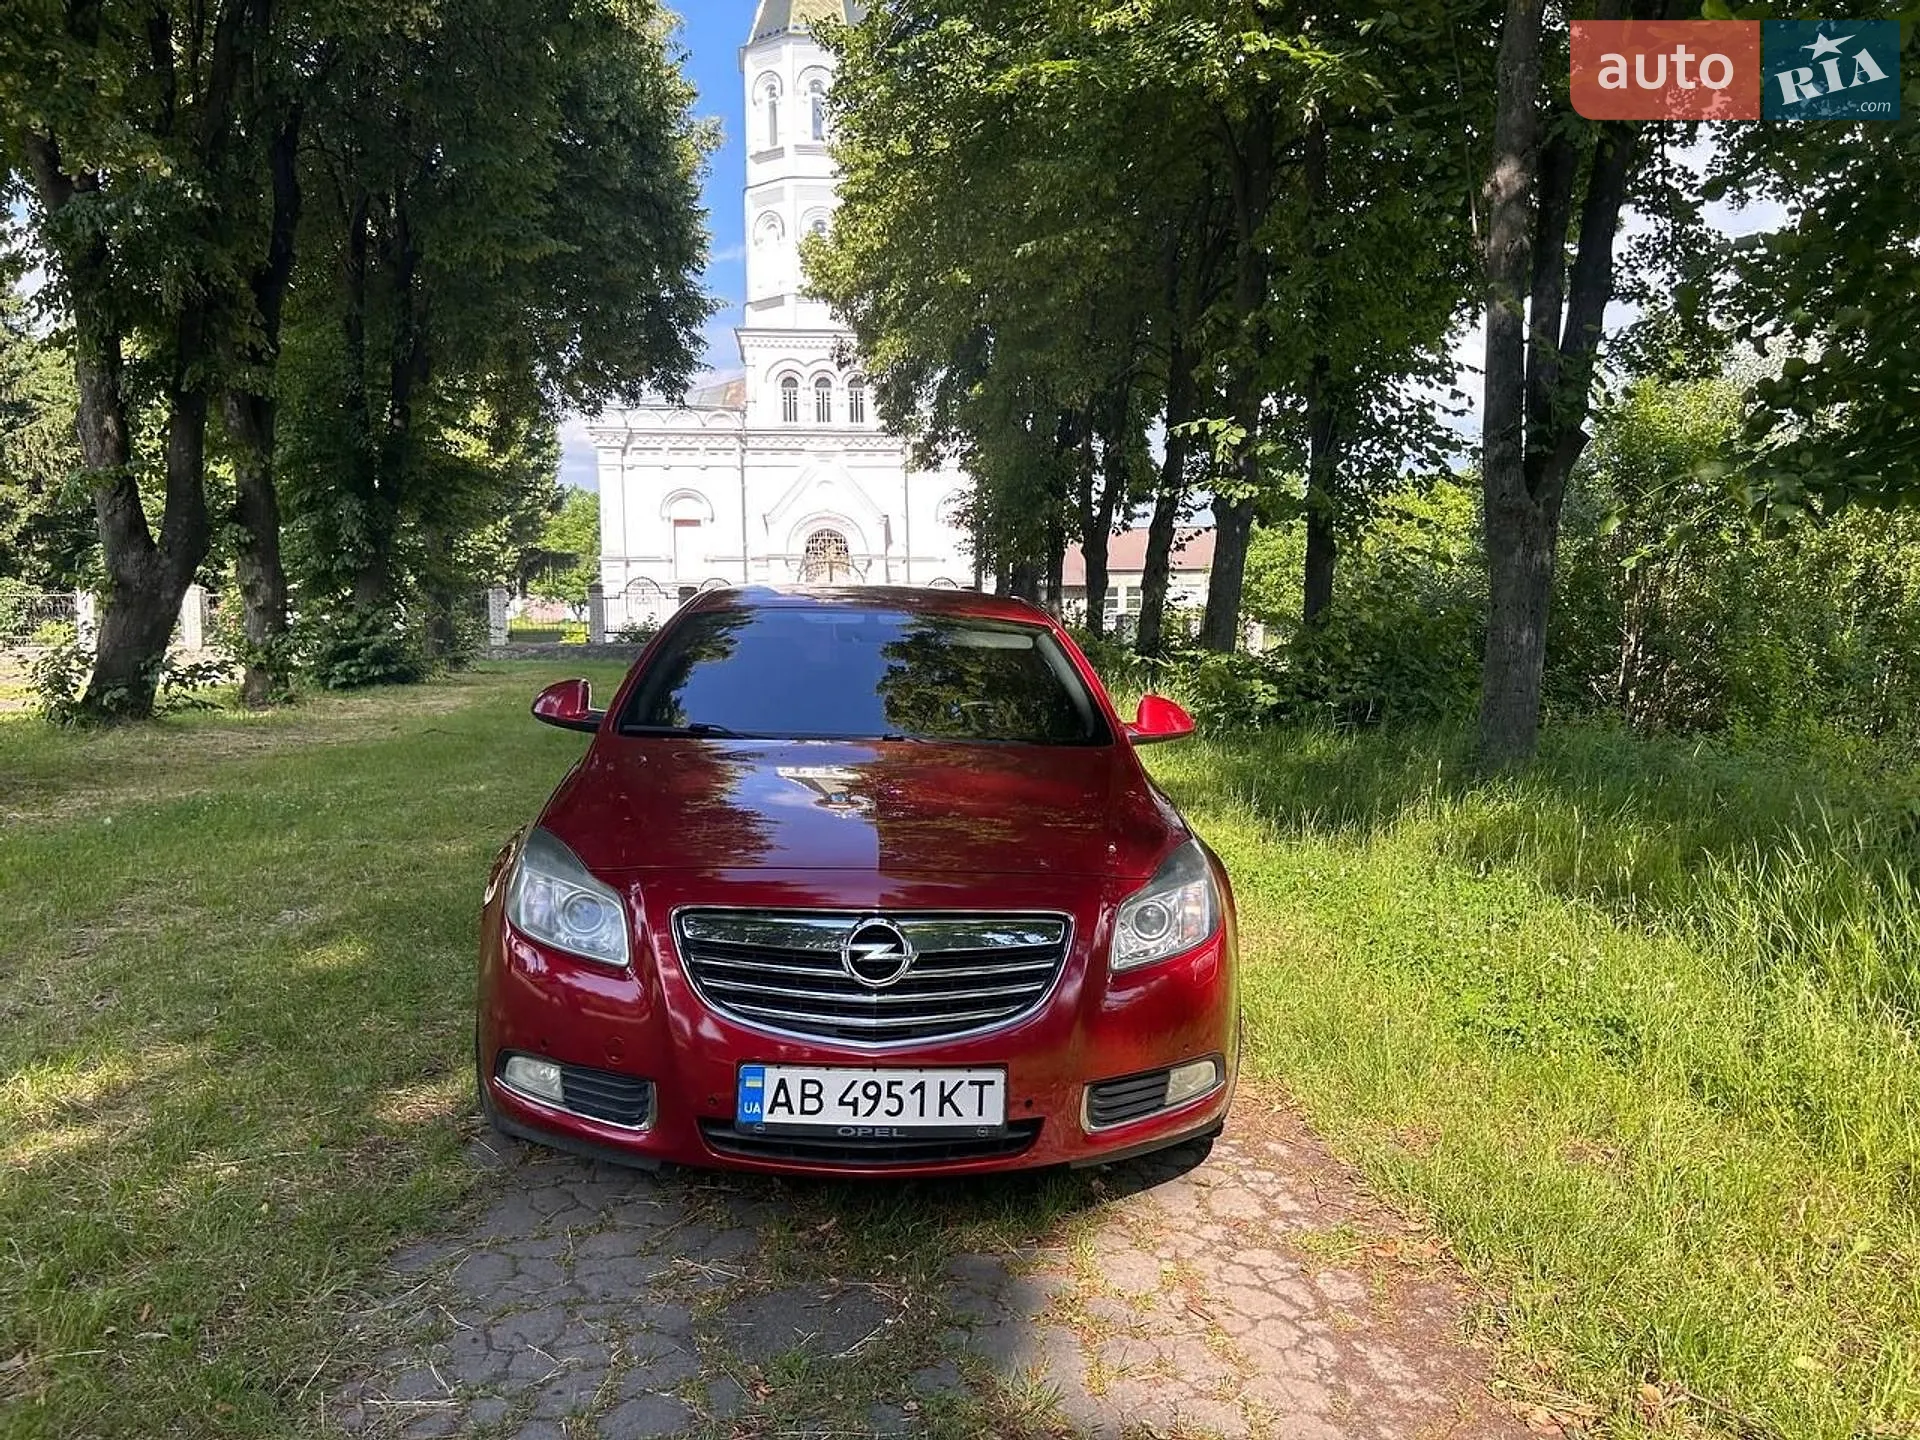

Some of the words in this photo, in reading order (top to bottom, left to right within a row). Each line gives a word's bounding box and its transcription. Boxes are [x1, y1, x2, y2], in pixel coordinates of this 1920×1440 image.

[767, 1077, 824, 1116] AB
[837, 1079, 926, 1118] 4951
[938, 1079, 996, 1118] KT
[744, 1102, 762, 1115] UA
[837, 1126, 907, 1138] OPEL
